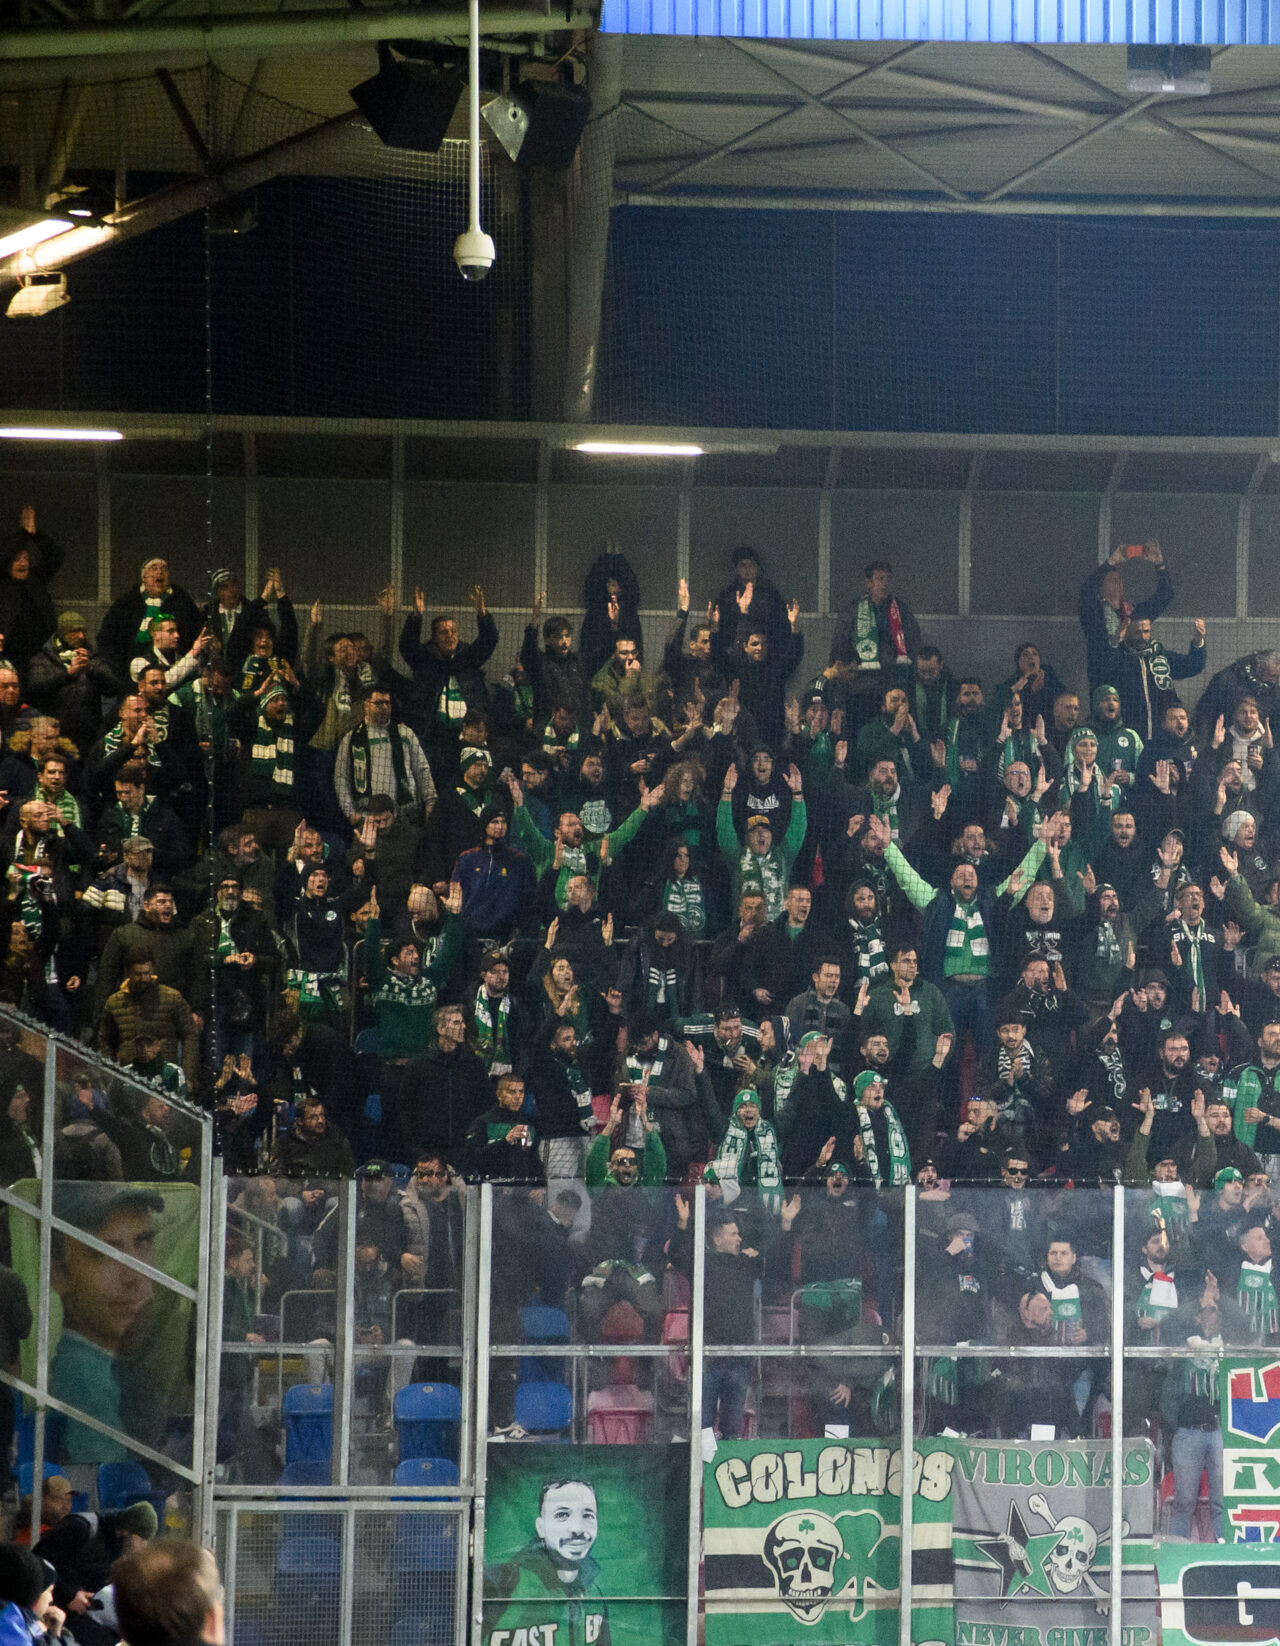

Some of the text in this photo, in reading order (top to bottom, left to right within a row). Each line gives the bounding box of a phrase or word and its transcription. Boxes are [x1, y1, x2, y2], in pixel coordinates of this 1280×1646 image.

[714, 1446, 955, 1508] COLONOS
[954, 1446, 1152, 1488] VIRONAS
[957, 1620, 1042, 1646] NEVER
[1046, 1626, 1109, 1646] GIVE
